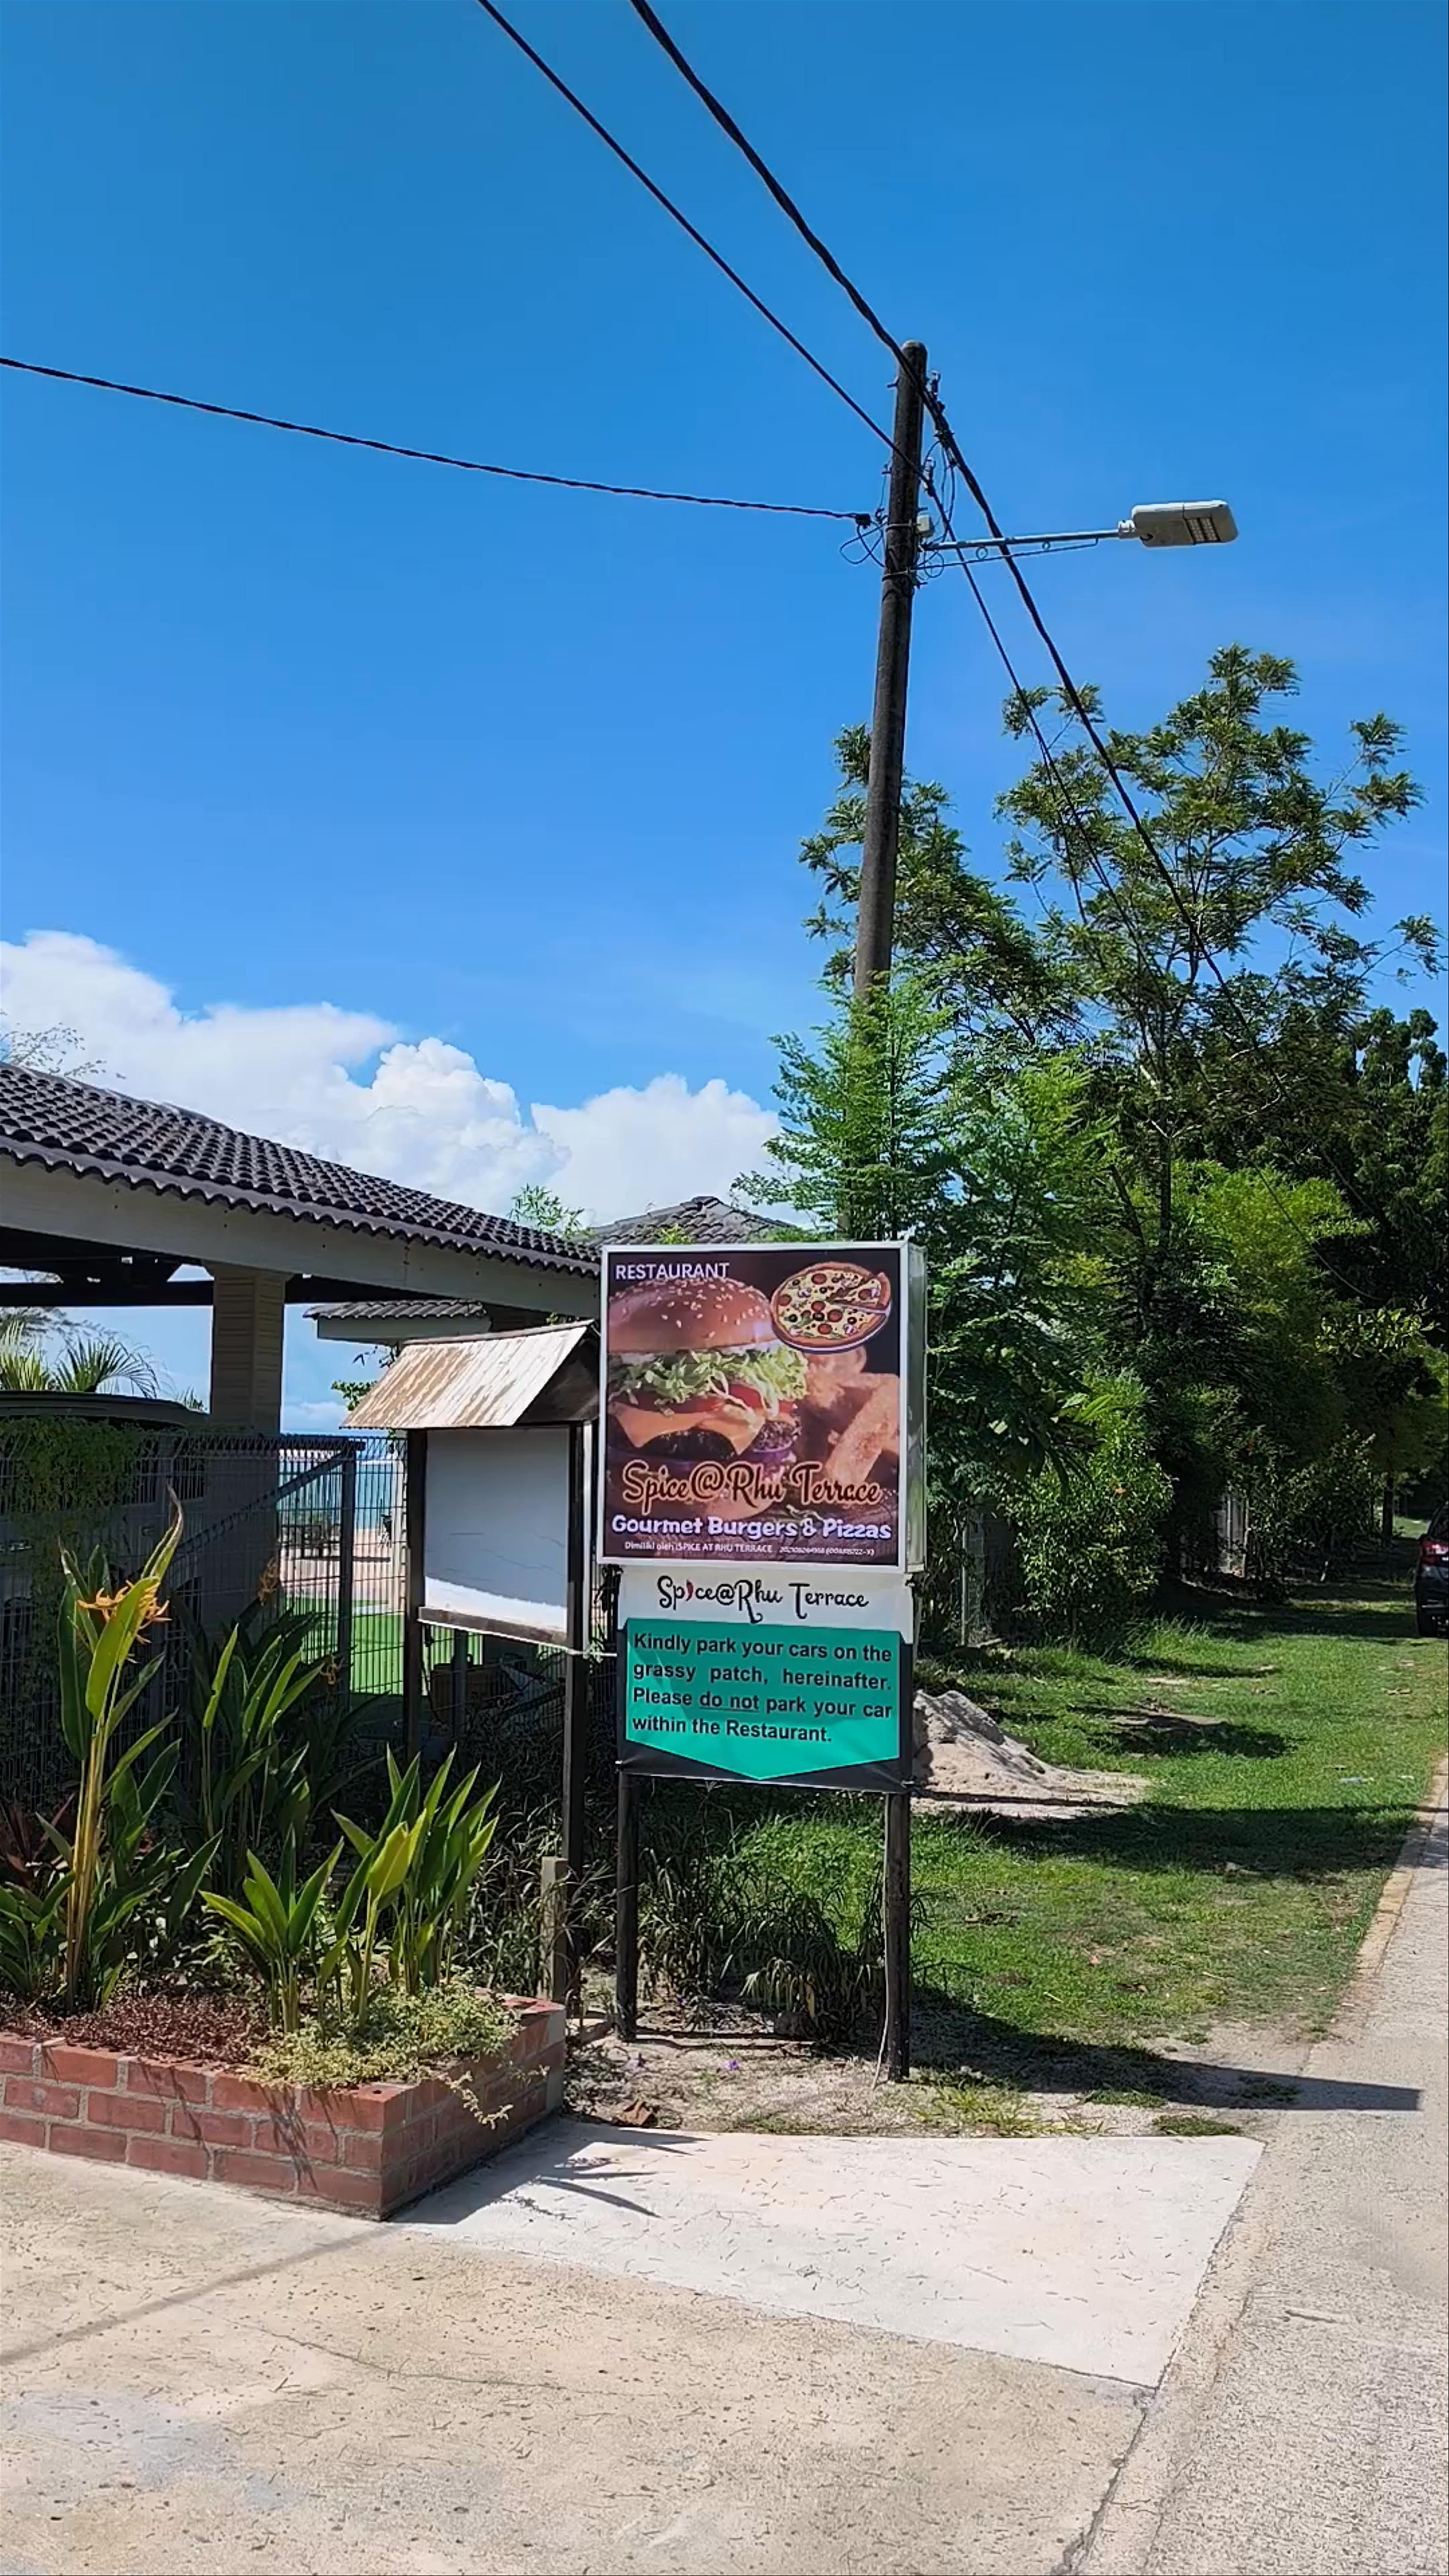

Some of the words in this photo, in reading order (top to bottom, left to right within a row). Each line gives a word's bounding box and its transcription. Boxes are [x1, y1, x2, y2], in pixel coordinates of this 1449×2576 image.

[616, 1263, 730, 1279] RESTAURANT
[789, 1461, 883, 1505] Terrace
[612, 1514, 703, 1534] Gourmet
[708, 1516, 797, 1540] Burgers
[802, 1518, 817, 1537] &
[823, 1518, 892, 1539] Pizzas
[735, 1544, 773, 1553] TERRACE
[788, 1583, 869, 1619] Terrace
[634, 1633, 691, 1654] Kindly
[697, 1638, 736, 1655] park
[742, 1641, 783, 1658] your
[789, 1643, 828, 1658] cars
[834, 1646, 857, 1659] on
[863, 1645, 892, 1662] the
[633, 1663, 696, 1682] grassy
[710, 1666, 768, 1684] patch,
[783, 1668, 891, 1690] hereinafter.
[633, 1687, 692, 1706] Please
[700, 1691, 722, 1707] do
[730, 1695, 759, 1709] not
[766, 1696, 806, 1714] park
[814, 1701, 856, 1718] your
[863, 1704, 893, 1718] car
[632, 1715, 686, 1732] within
[692, 1718, 720, 1735] the
[726, 1719, 832, 1742] Restaurant.
